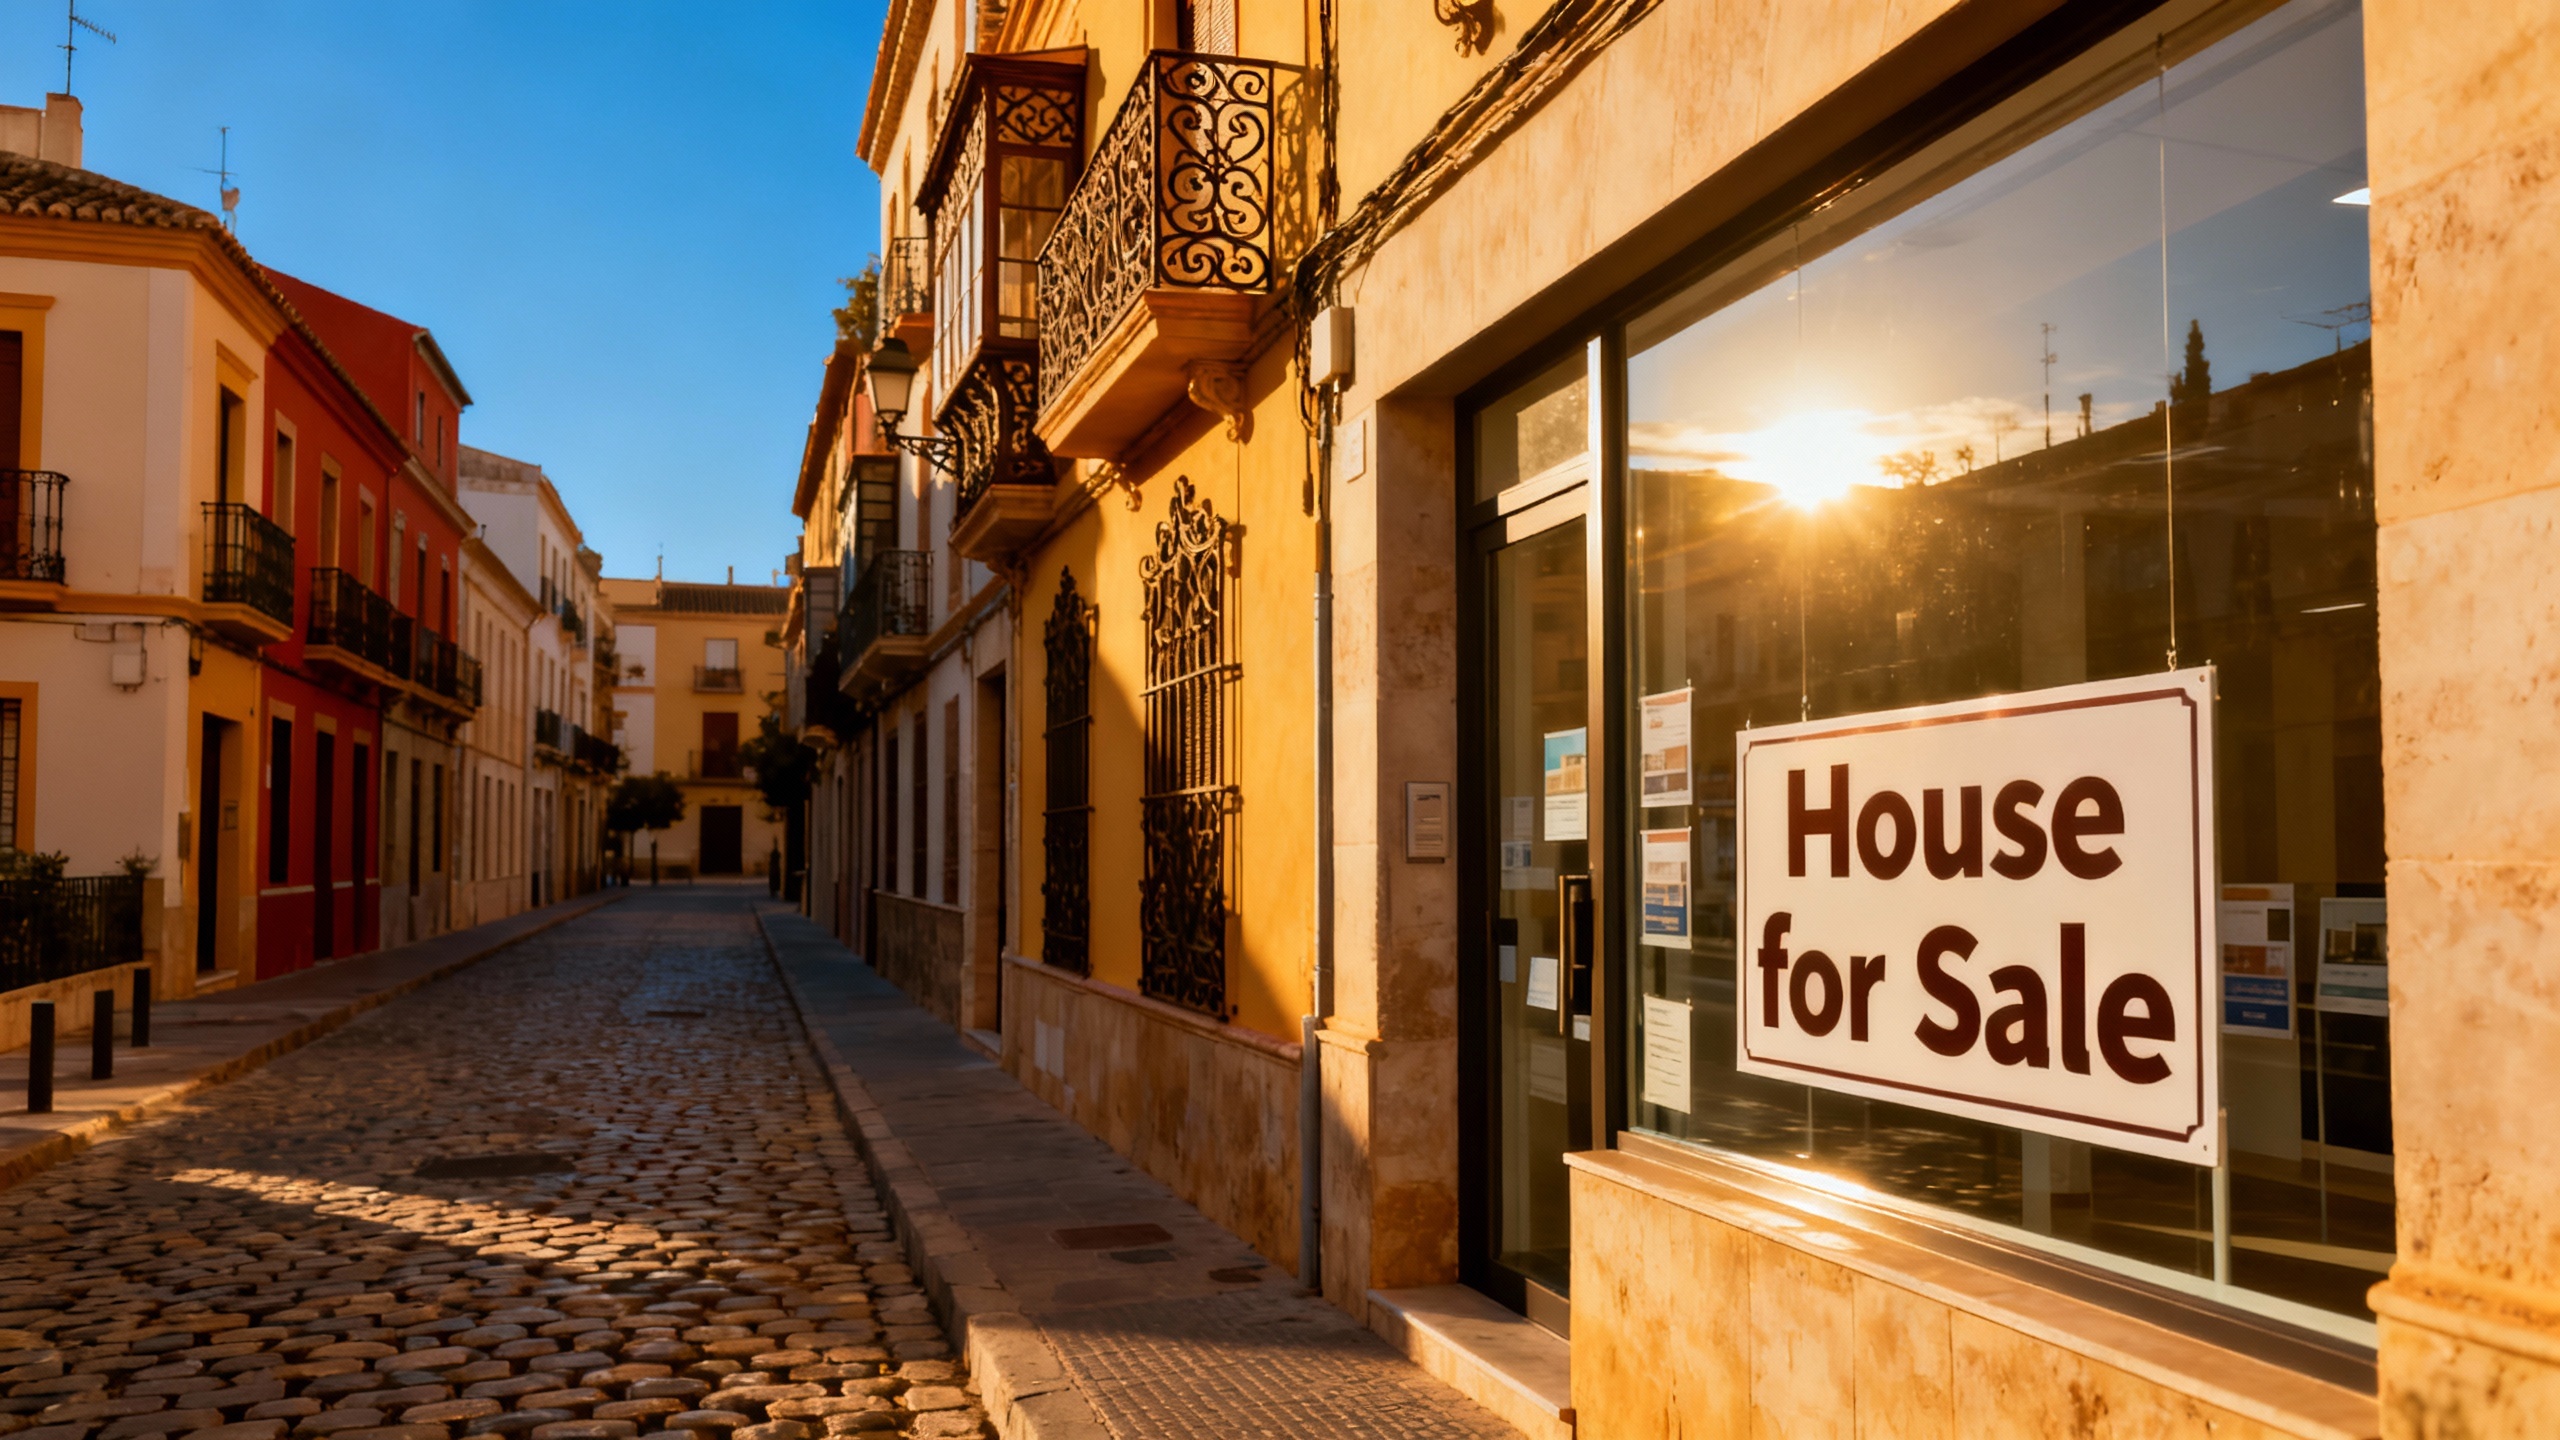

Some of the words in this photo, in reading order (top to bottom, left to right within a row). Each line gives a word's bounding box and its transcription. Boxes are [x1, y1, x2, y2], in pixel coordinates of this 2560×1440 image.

[1788, 763, 2125, 881] House
[1757, 911, 1886, 1043] for
[1914, 922, 2176, 1085] Sale
